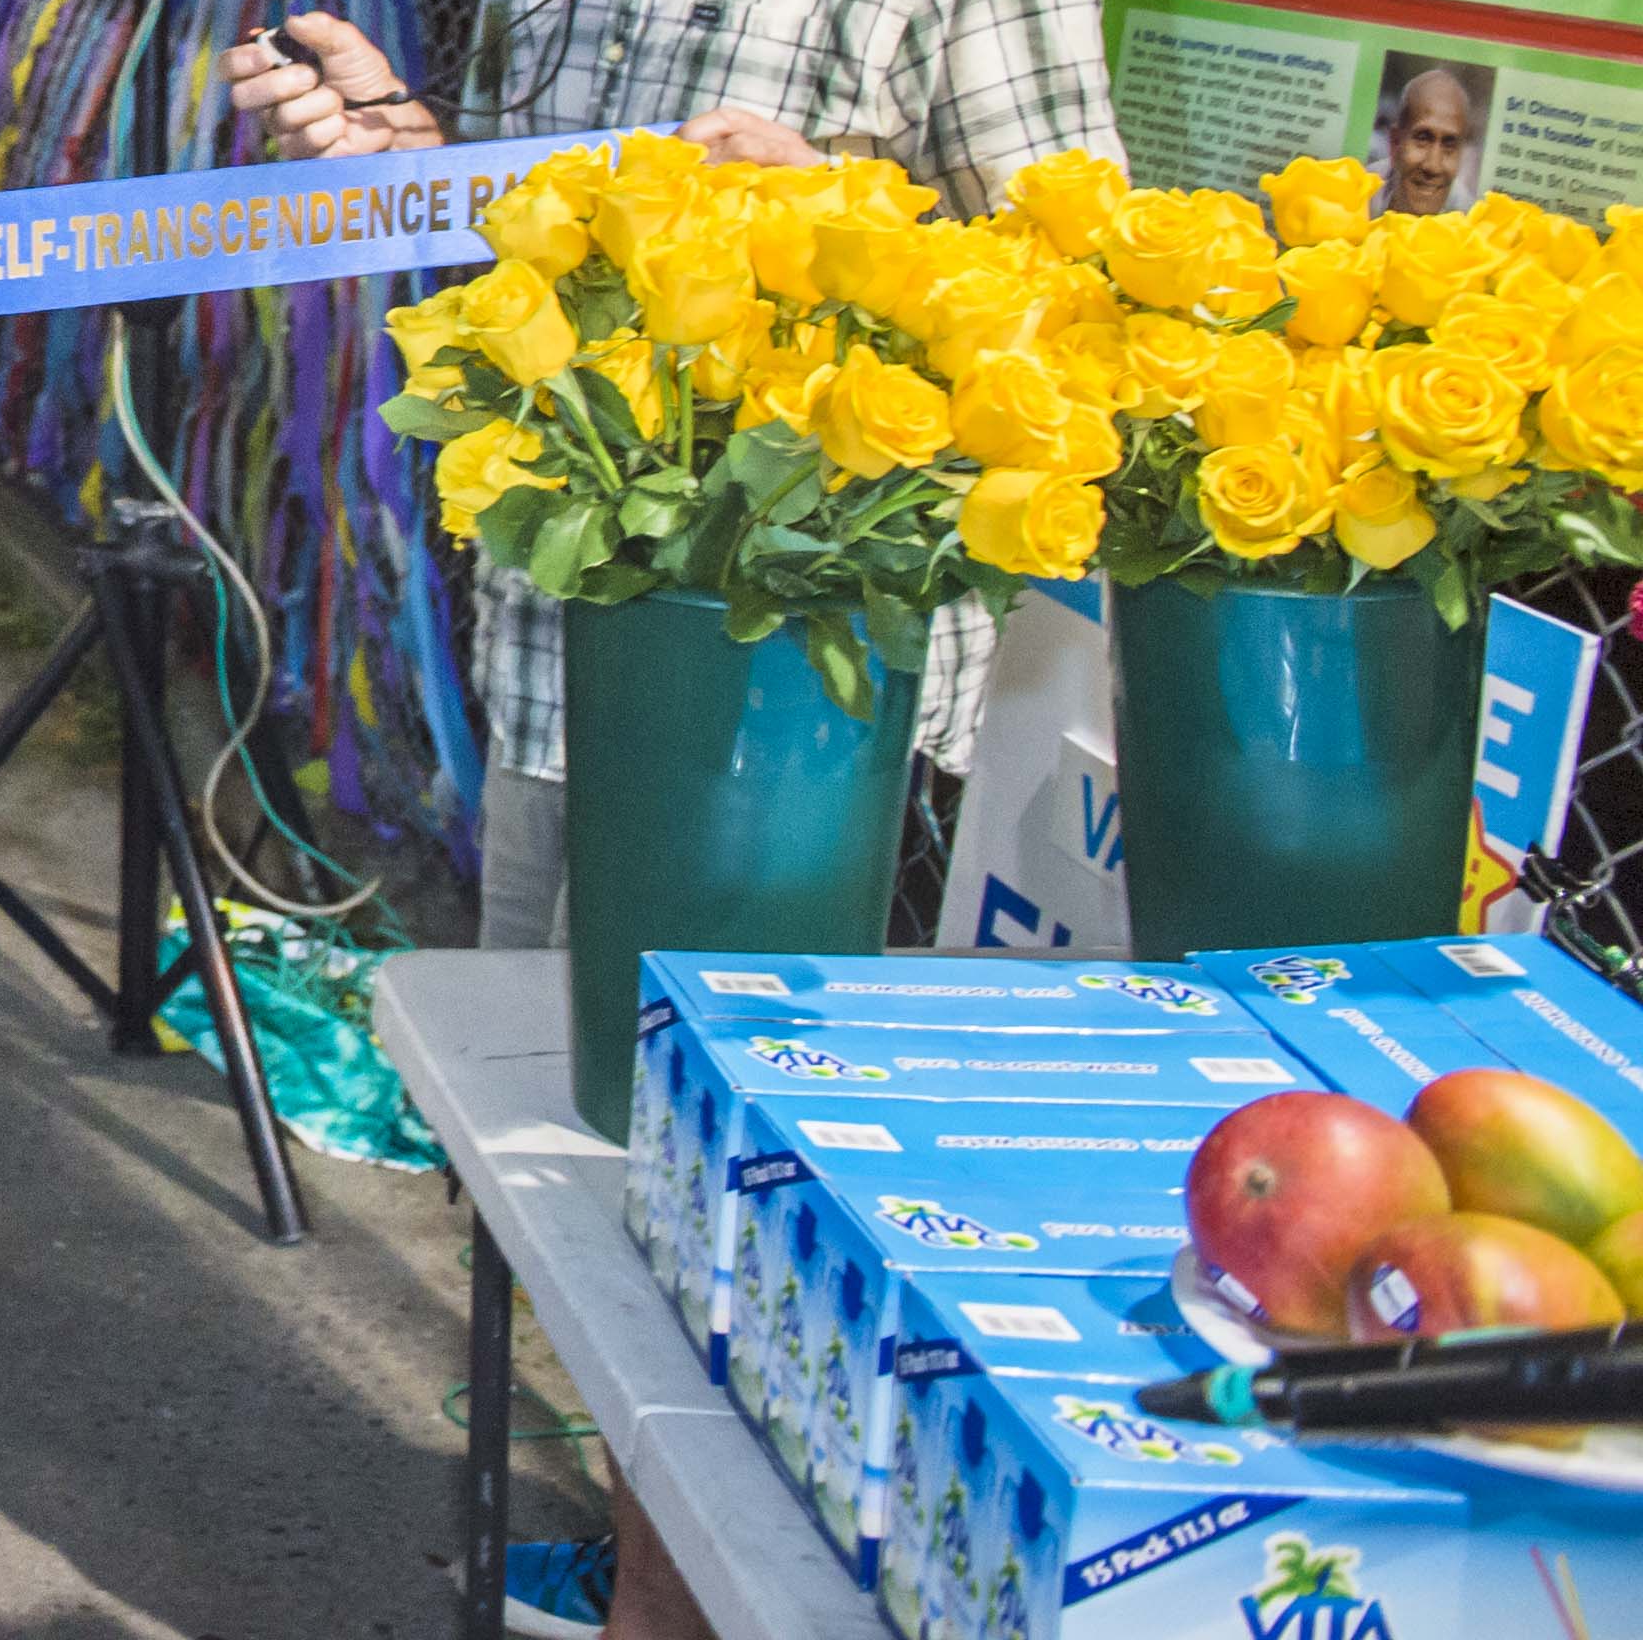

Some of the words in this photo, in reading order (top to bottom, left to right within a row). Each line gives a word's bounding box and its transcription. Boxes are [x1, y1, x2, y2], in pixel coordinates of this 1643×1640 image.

[1080, 1559, 1115, 1589] 15
[1111, 1531, 1173, 1575] Pack
[1170, 1512, 1217, 1549] 11.1
[1217, 1501, 1251, 1528] oz
[1239, 1572, 1398, 1640] VITA
